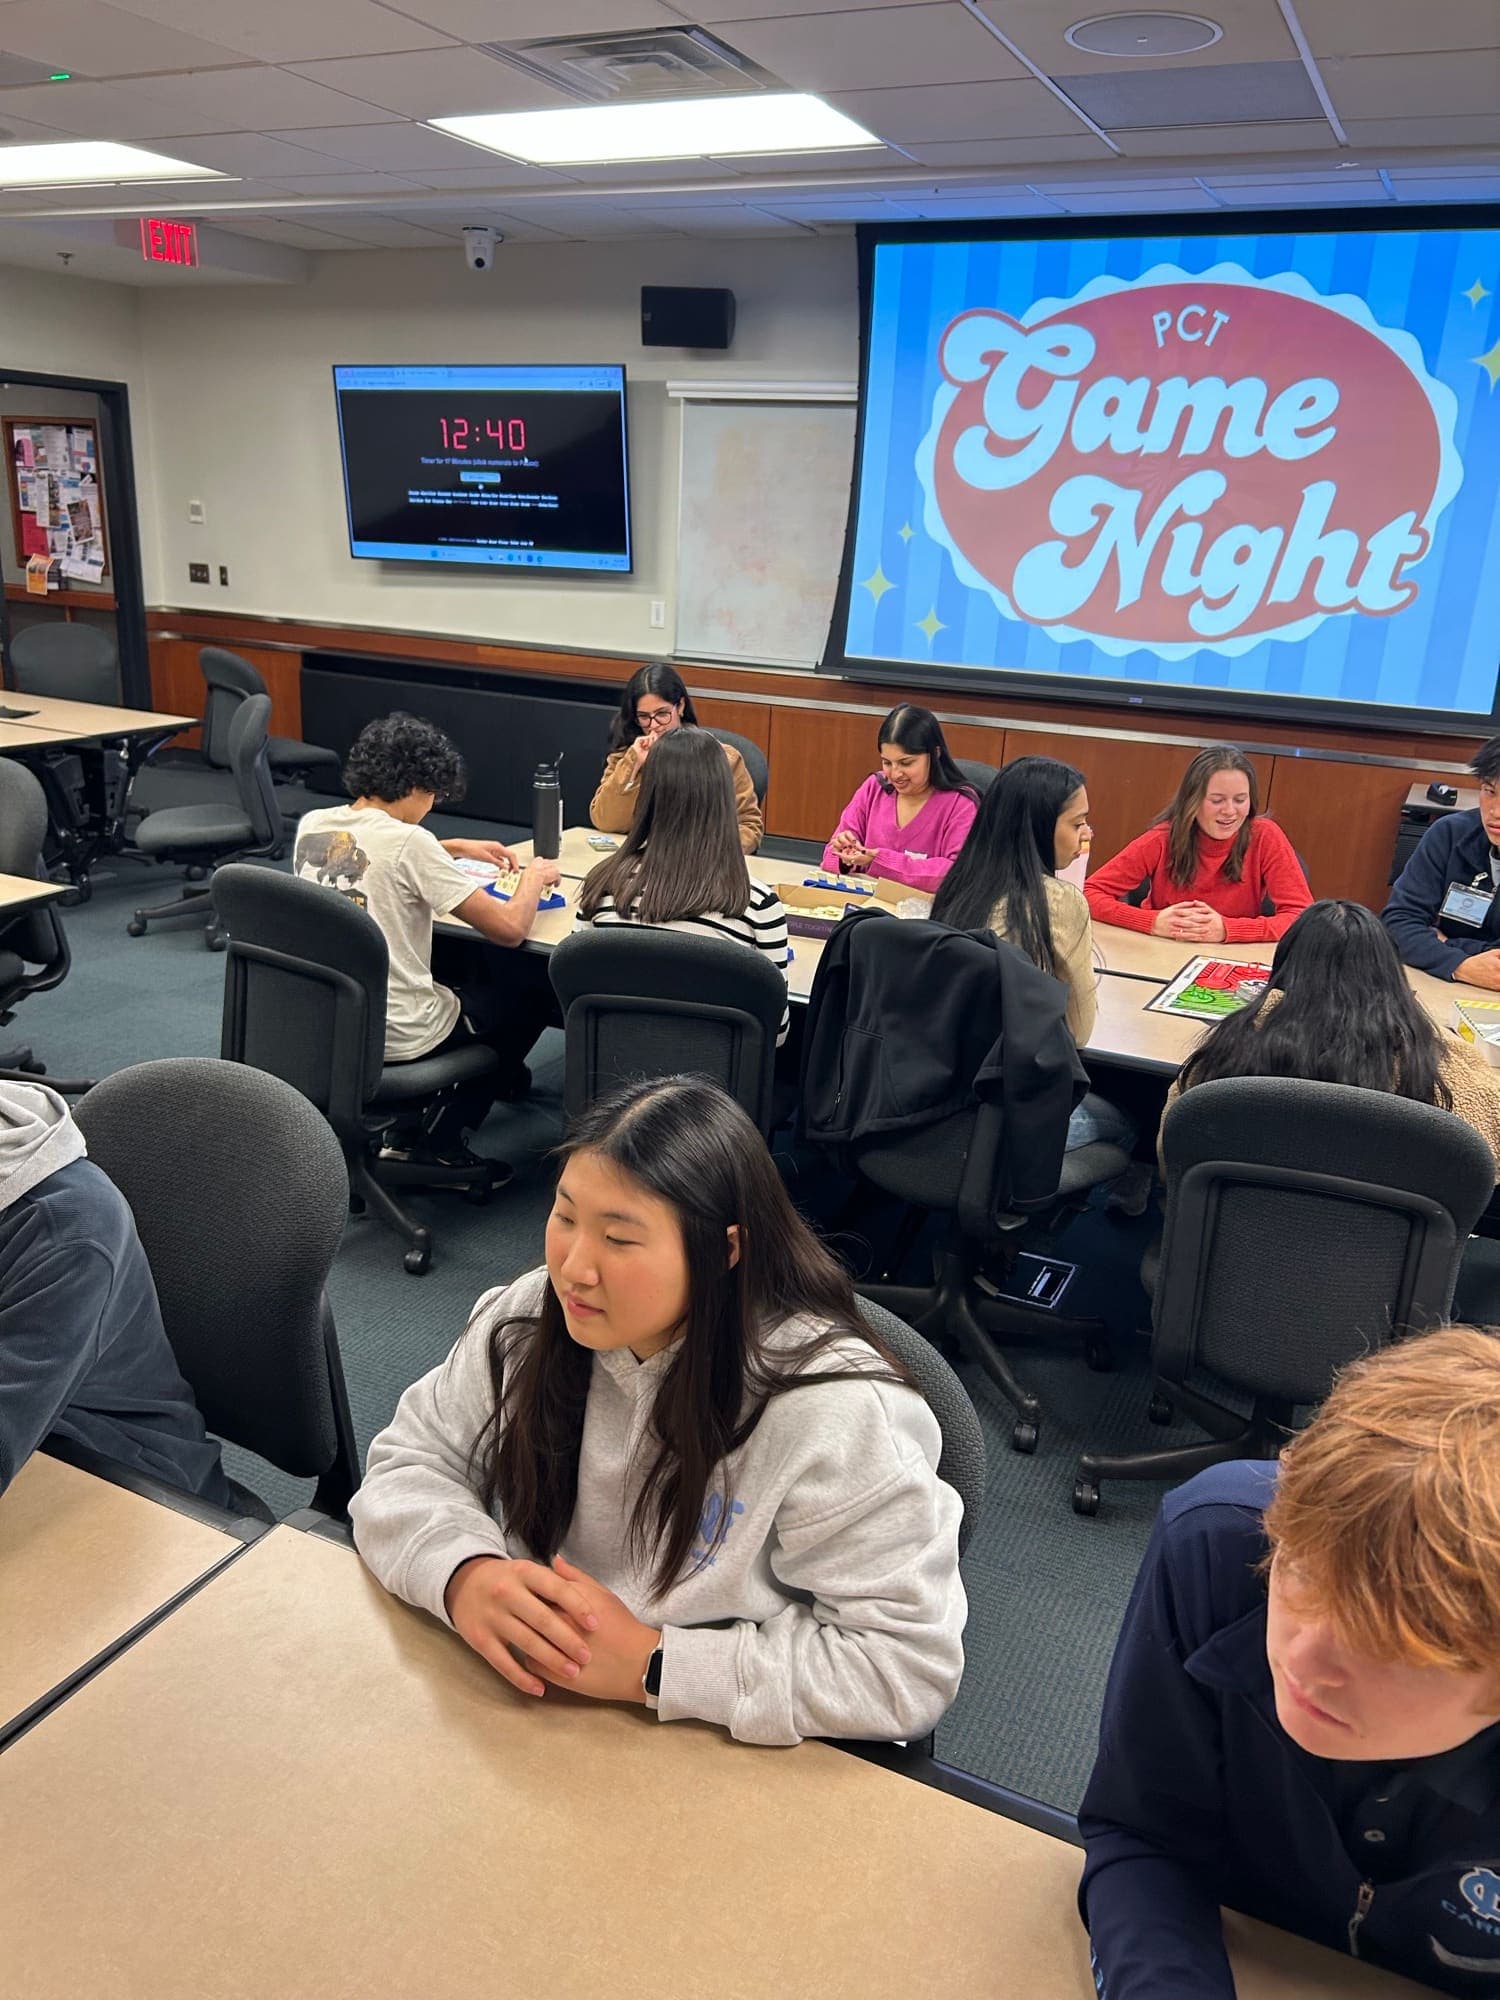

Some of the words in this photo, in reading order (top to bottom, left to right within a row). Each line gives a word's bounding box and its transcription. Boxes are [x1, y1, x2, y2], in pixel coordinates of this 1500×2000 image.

[148, 219, 191, 266] EXIT
[1152, 304, 1231, 348] PCT
[942, 314, 1340, 491] Game
[440, 417, 527, 451] 12:40
[1012, 470, 1419, 637] Night
